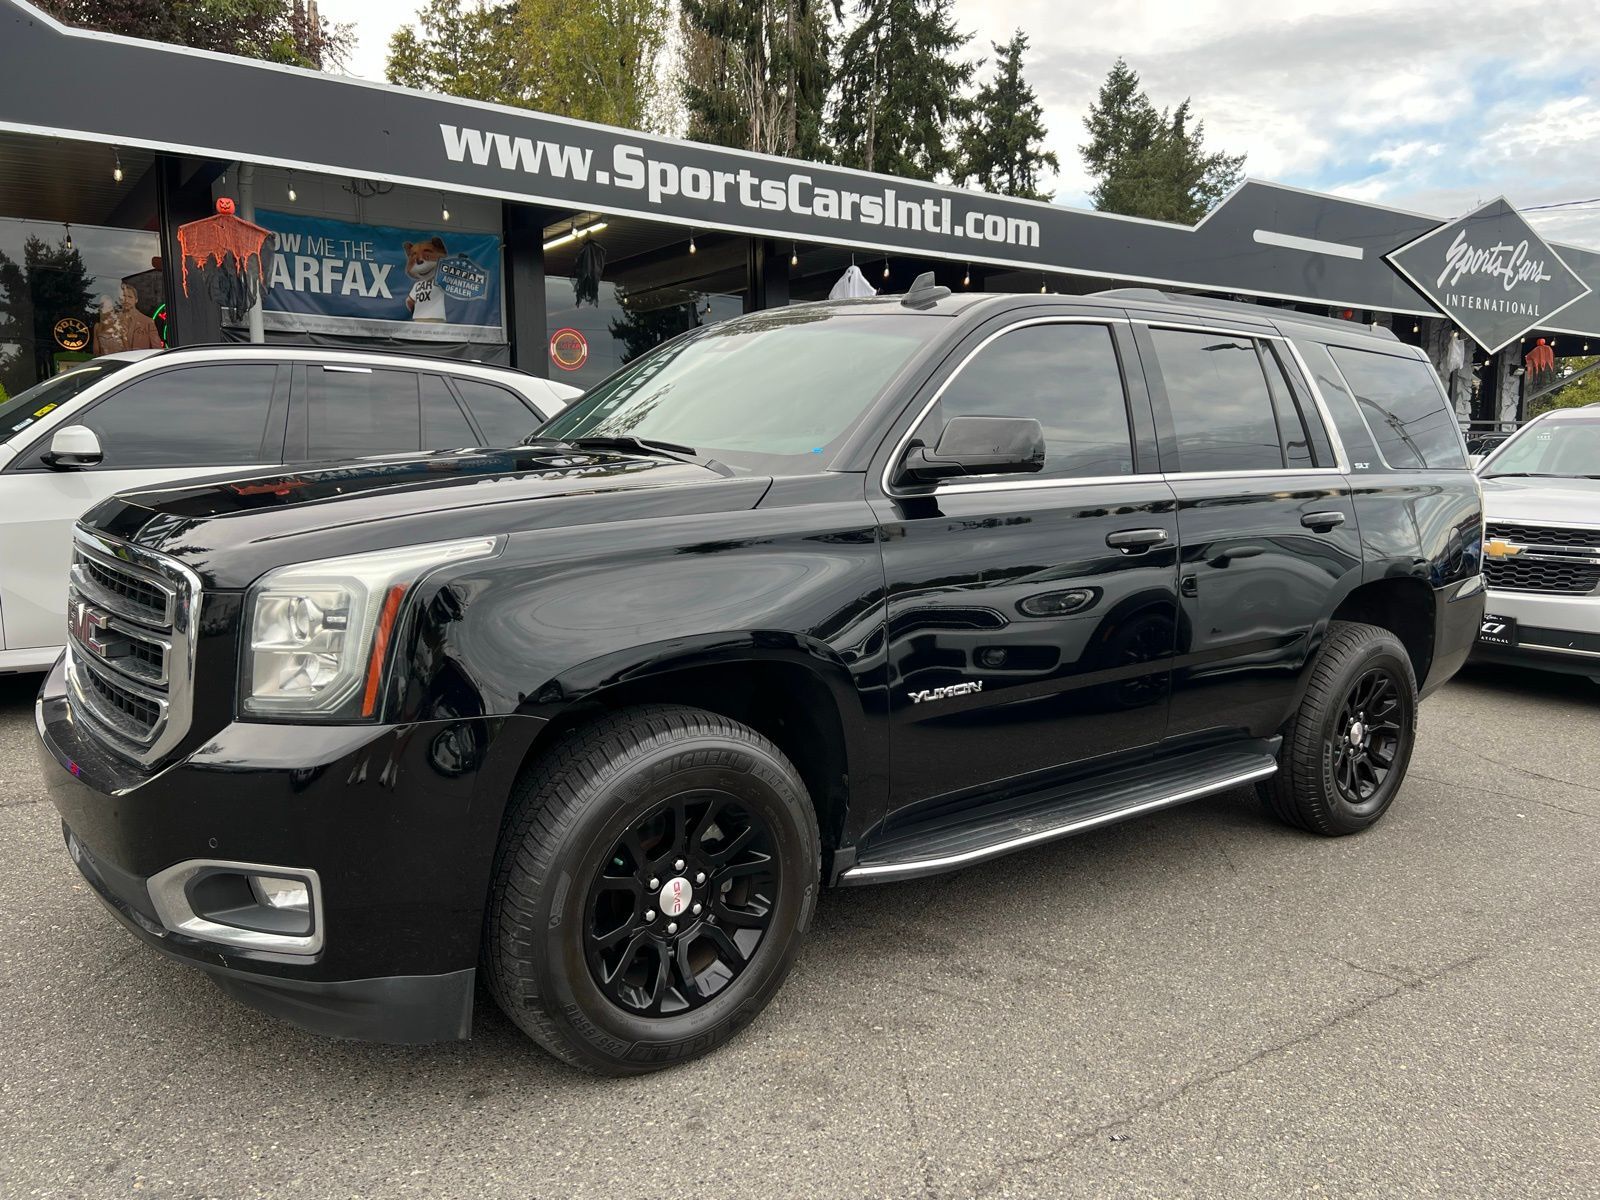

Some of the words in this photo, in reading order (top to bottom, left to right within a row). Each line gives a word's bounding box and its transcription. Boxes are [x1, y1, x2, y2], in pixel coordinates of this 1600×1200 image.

[439, 123, 1040, 247] www.SportsCarsIntl.com
[274, 231, 301, 253] OW
[307, 235, 336, 257] ME
[340, 239, 374, 261] THE
[1437, 229, 1514, 288] Sports
[1503, 240, 1552, 291] Cars
[270, 253, 393, 299] ARFAX
[416, 280, 432, 292] CAR
[442, 264, 485, 284] CARFAX
[442, 275, 480, 292] ADVANTAGE
[416, 290, 432, 303] FOX
[445, 284, 472, 298] DEALER
[1446, 293, 1540, 317] INTERNATIONAL
[57, 320, 88, 333] POLLY
[63, 339, 83, 347] GAS
[907, 680, 983, 704] YUKON
[654, 750, 753, 777] MICHELIN
[1324, 744, 1336, 806] MICHELIN
[673, 881, 681, 913] GMC
